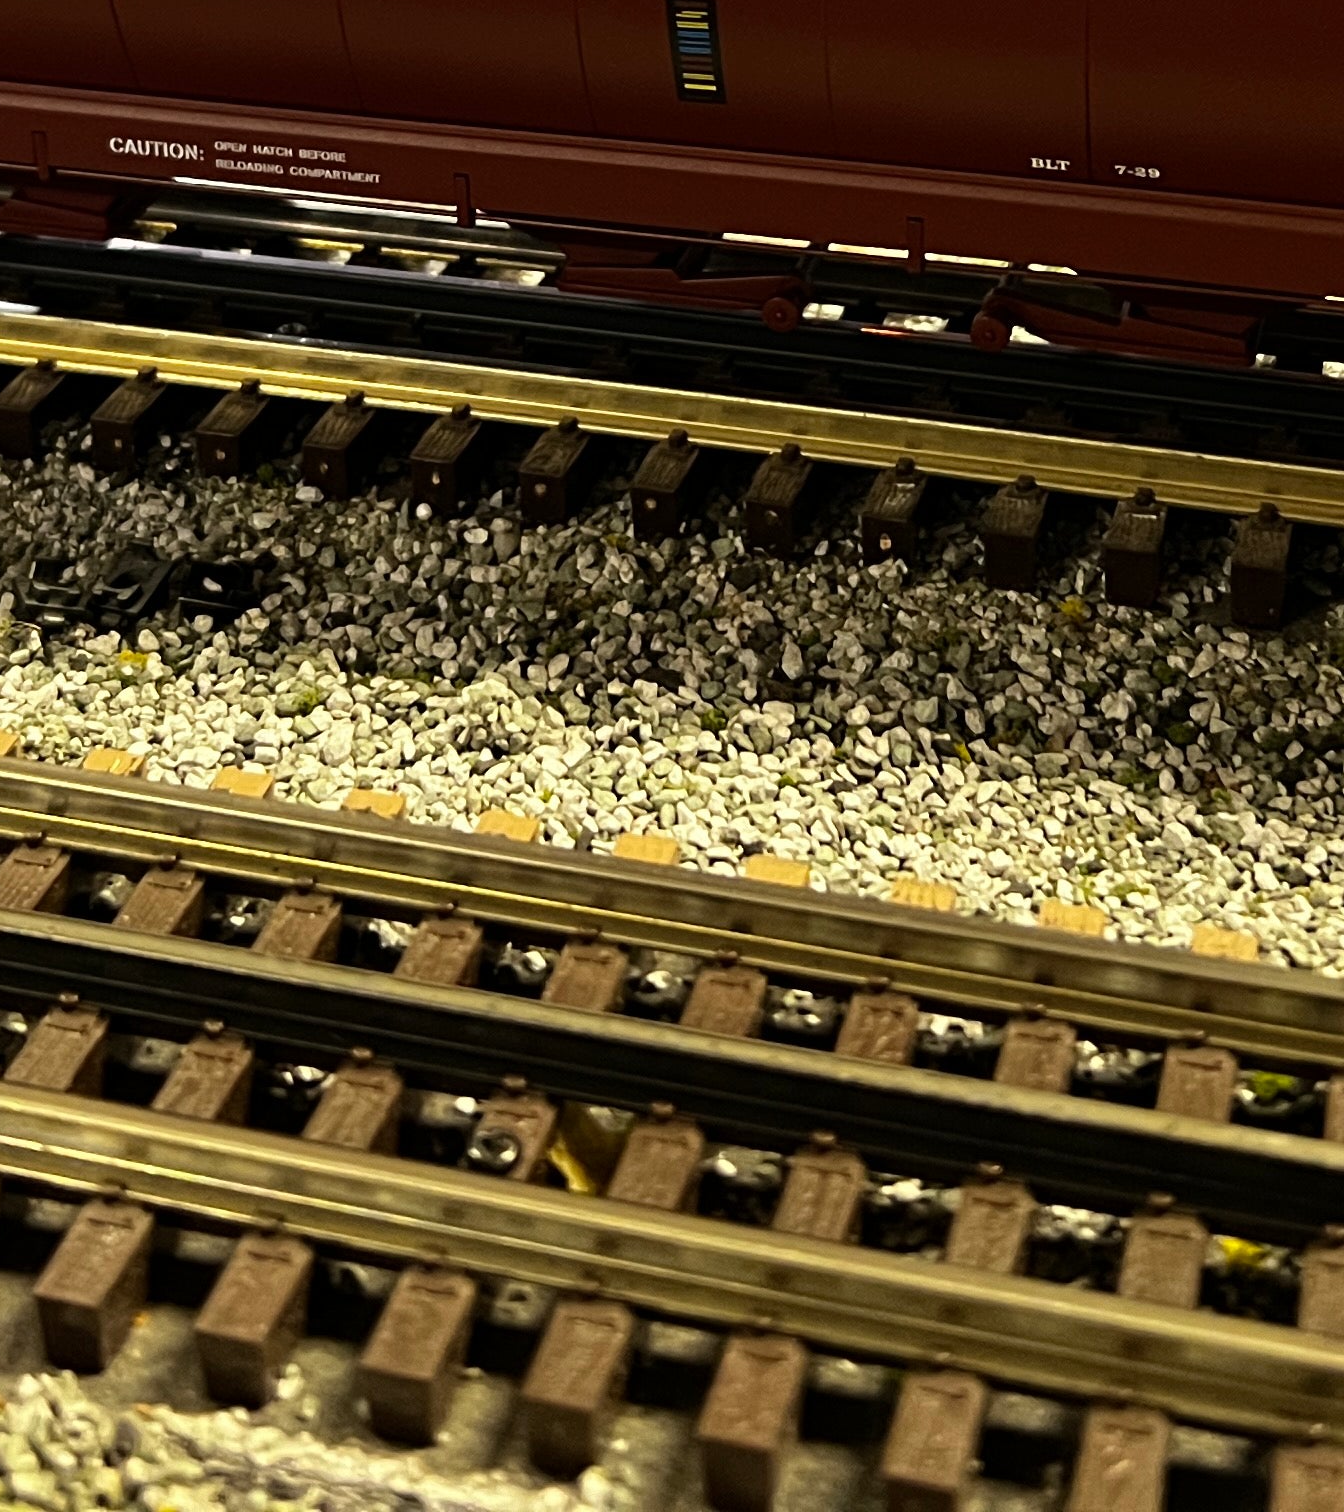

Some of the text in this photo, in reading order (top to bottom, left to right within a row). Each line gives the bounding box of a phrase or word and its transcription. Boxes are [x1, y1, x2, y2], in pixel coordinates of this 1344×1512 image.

[109, 137, 204, 161] CAUTION:
[214, 141, 346, 163] OPEN HATCH BEFORE
[215, 159, 381, 184] RELOADING COMPARTMENT
[1030, 157, 1161, 179] BLT 7-29
